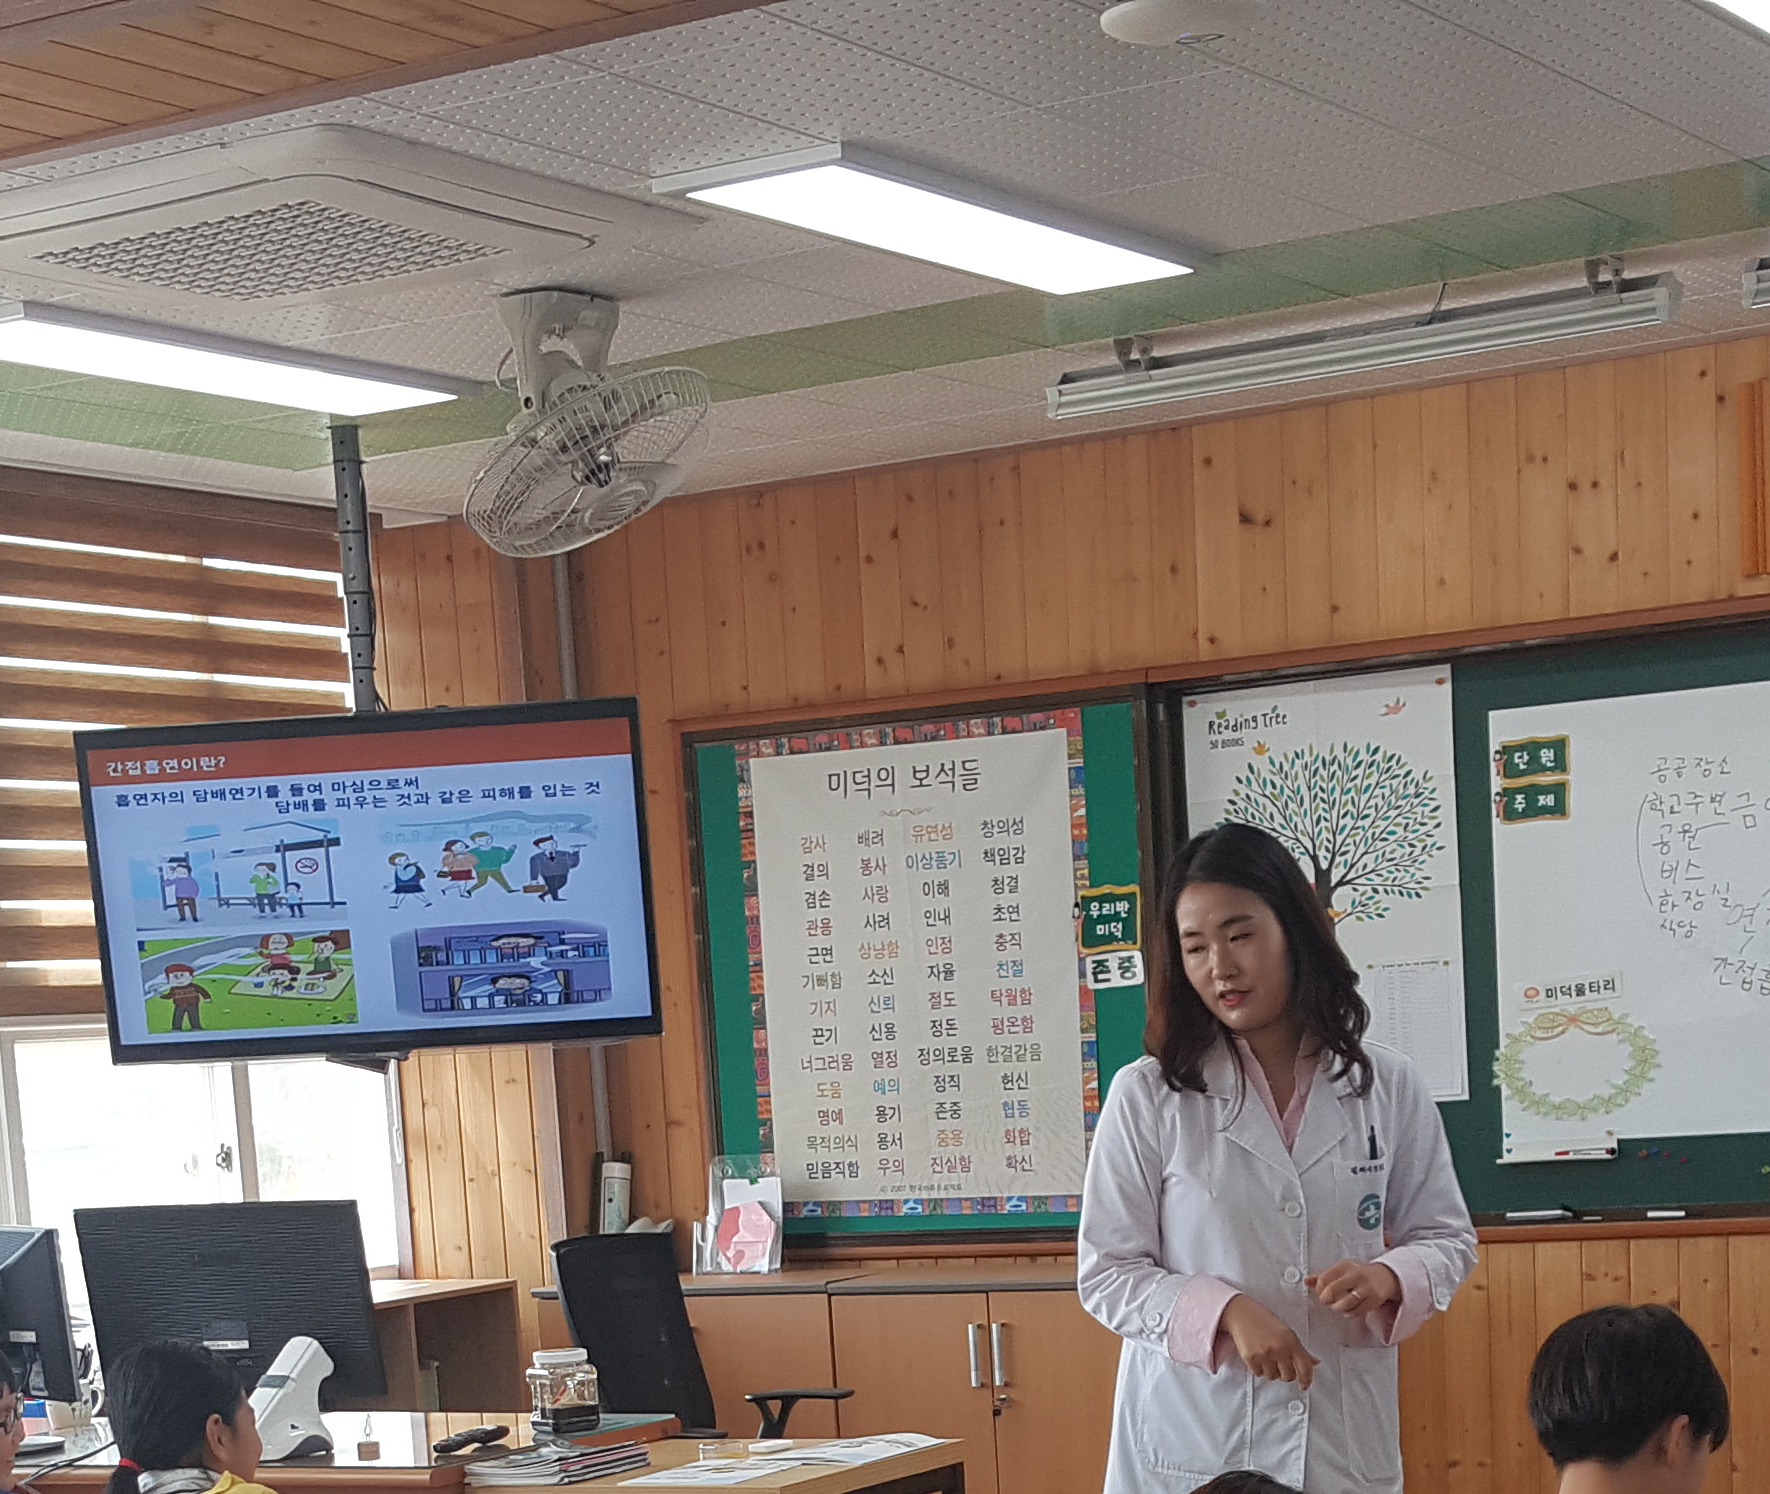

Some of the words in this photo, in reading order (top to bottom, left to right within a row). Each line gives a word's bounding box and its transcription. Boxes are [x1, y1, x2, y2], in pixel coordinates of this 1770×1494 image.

[1209, 714, 1258, 735] Reading
[1261, 712, 1287, 728] Tree
[106, 756, 226, 777] 간접흡연이란?
[828, 766, 896, 800] 미덕의
[910, 759, 982, 793] 보석들
[1650, 756, 1732, 784] 공공장소
[115, 790, 185, 808] 흡연자의
[193, 785, 281, 804] 담배연기를
[288, 782, 323, 798] 들여
[331, 776, 419, 795] 마심으로써
[275, 798, 327, 814] 담배를
[335, 796, 388, 811] 피우는
[396, 792, 431, 808] 것과
[439, 788, 473, 805] 같은
[481, 785, 533, 801] 피해를
[541, 782, 577, 799] 입는
[584, 780, 602, 796] 것
[1647, 791, 1727, 818] 학교주변
[801, 834, 827, 854] 감사
[857, 828, 885, 848] 배려
[911, 822, 954, 844] 유연성
[981, 816, 1025, 839] 창의성
[1652, 822, 1702, 855] 공원
[802, 862, 829, 881] 결의
[859, 856, 887, 876] 봉사
[906, 849, 963, 871] 이상품기
[982, 844, 1026, 867] 책임감
[1660, 858, 1704, 884] 버스
[805, 889, 831, 909] 겸손
[862, 885, 889, 904] 사랑
[922, 879, 950, 899] 이해
[991, 874, 1019, 895] 청결
[1659, 882, 1731, 914] 화장실
[806, 917, 833, 937] 관용
[864, 912, 890, 931] 사려
[923, 907, 952, 927] 인내
[992, 903, 1021, 923] 초연
[1089, 901, 1130, 918] 우리반
[1096, 921, 1123, 938] 미덕
[1660, 918, 1698, 939] 식당
[807, 945, 834, 964] 근면
[859, 939, 900, 960] 상냥함
[926, 935, 953, 956] 인정
[994, 931, 1023, 952] 충직
[801, 971, 842, 990] 기뻐함
[867, 967, 895, 986] 소신
[927, 963, 956, 982] 자율
[996, 958, 1024, 979] 친절
[1545, 978, 1616, 1001] 미덕울타리
[810, 999, 837, 1018] 기지
[868, 994, 896, 1013] 신뢰
[928, 990, 957, 1010] 절도
[990, 986, 1033, 1006] 탁월함
[812, 1026, 838, 1045] 끈기
[869, 1022, 897, 1042] 신용
[930, 1018, 959, 1038] 정돈
[990, 1014, 1035, 1036] 평온함
[801, 1052, 854, 1073] 너그러움
[871, 1049, 899, 1070] 열정
[917, 1045, 974, 1066] 정의로움
[985, 1042, 1043, 1064] 한결같음
[816, 1080, 843, 1099] 도움
[873, 1077, 901, 1096] 예의
[933, 1073, 961, 1093] 정직
[1001, 1070, 1029, 1091] 헌신
[817, 1108, 844, 1127] 명예
[875, 1104, 902, 1124] 용기
[934, 1101, 962, 1121] 존중
[1001, 1099, 1031, 1119] 협동
[806, 1134, 859, 1152] 목적의식
[877, 1131, 903, 1151] 용서
[936, 1129, 964, 1148] 중용
[1004, 1127, 1032, 1147] 화합
[806, 1160, 860, 1180] 믿음직함
[878, 1157, 906, 1177] 우의
[930, 1154, 973, 1174] 진실함
[1005, 1153, 1033, 1173] 확신
